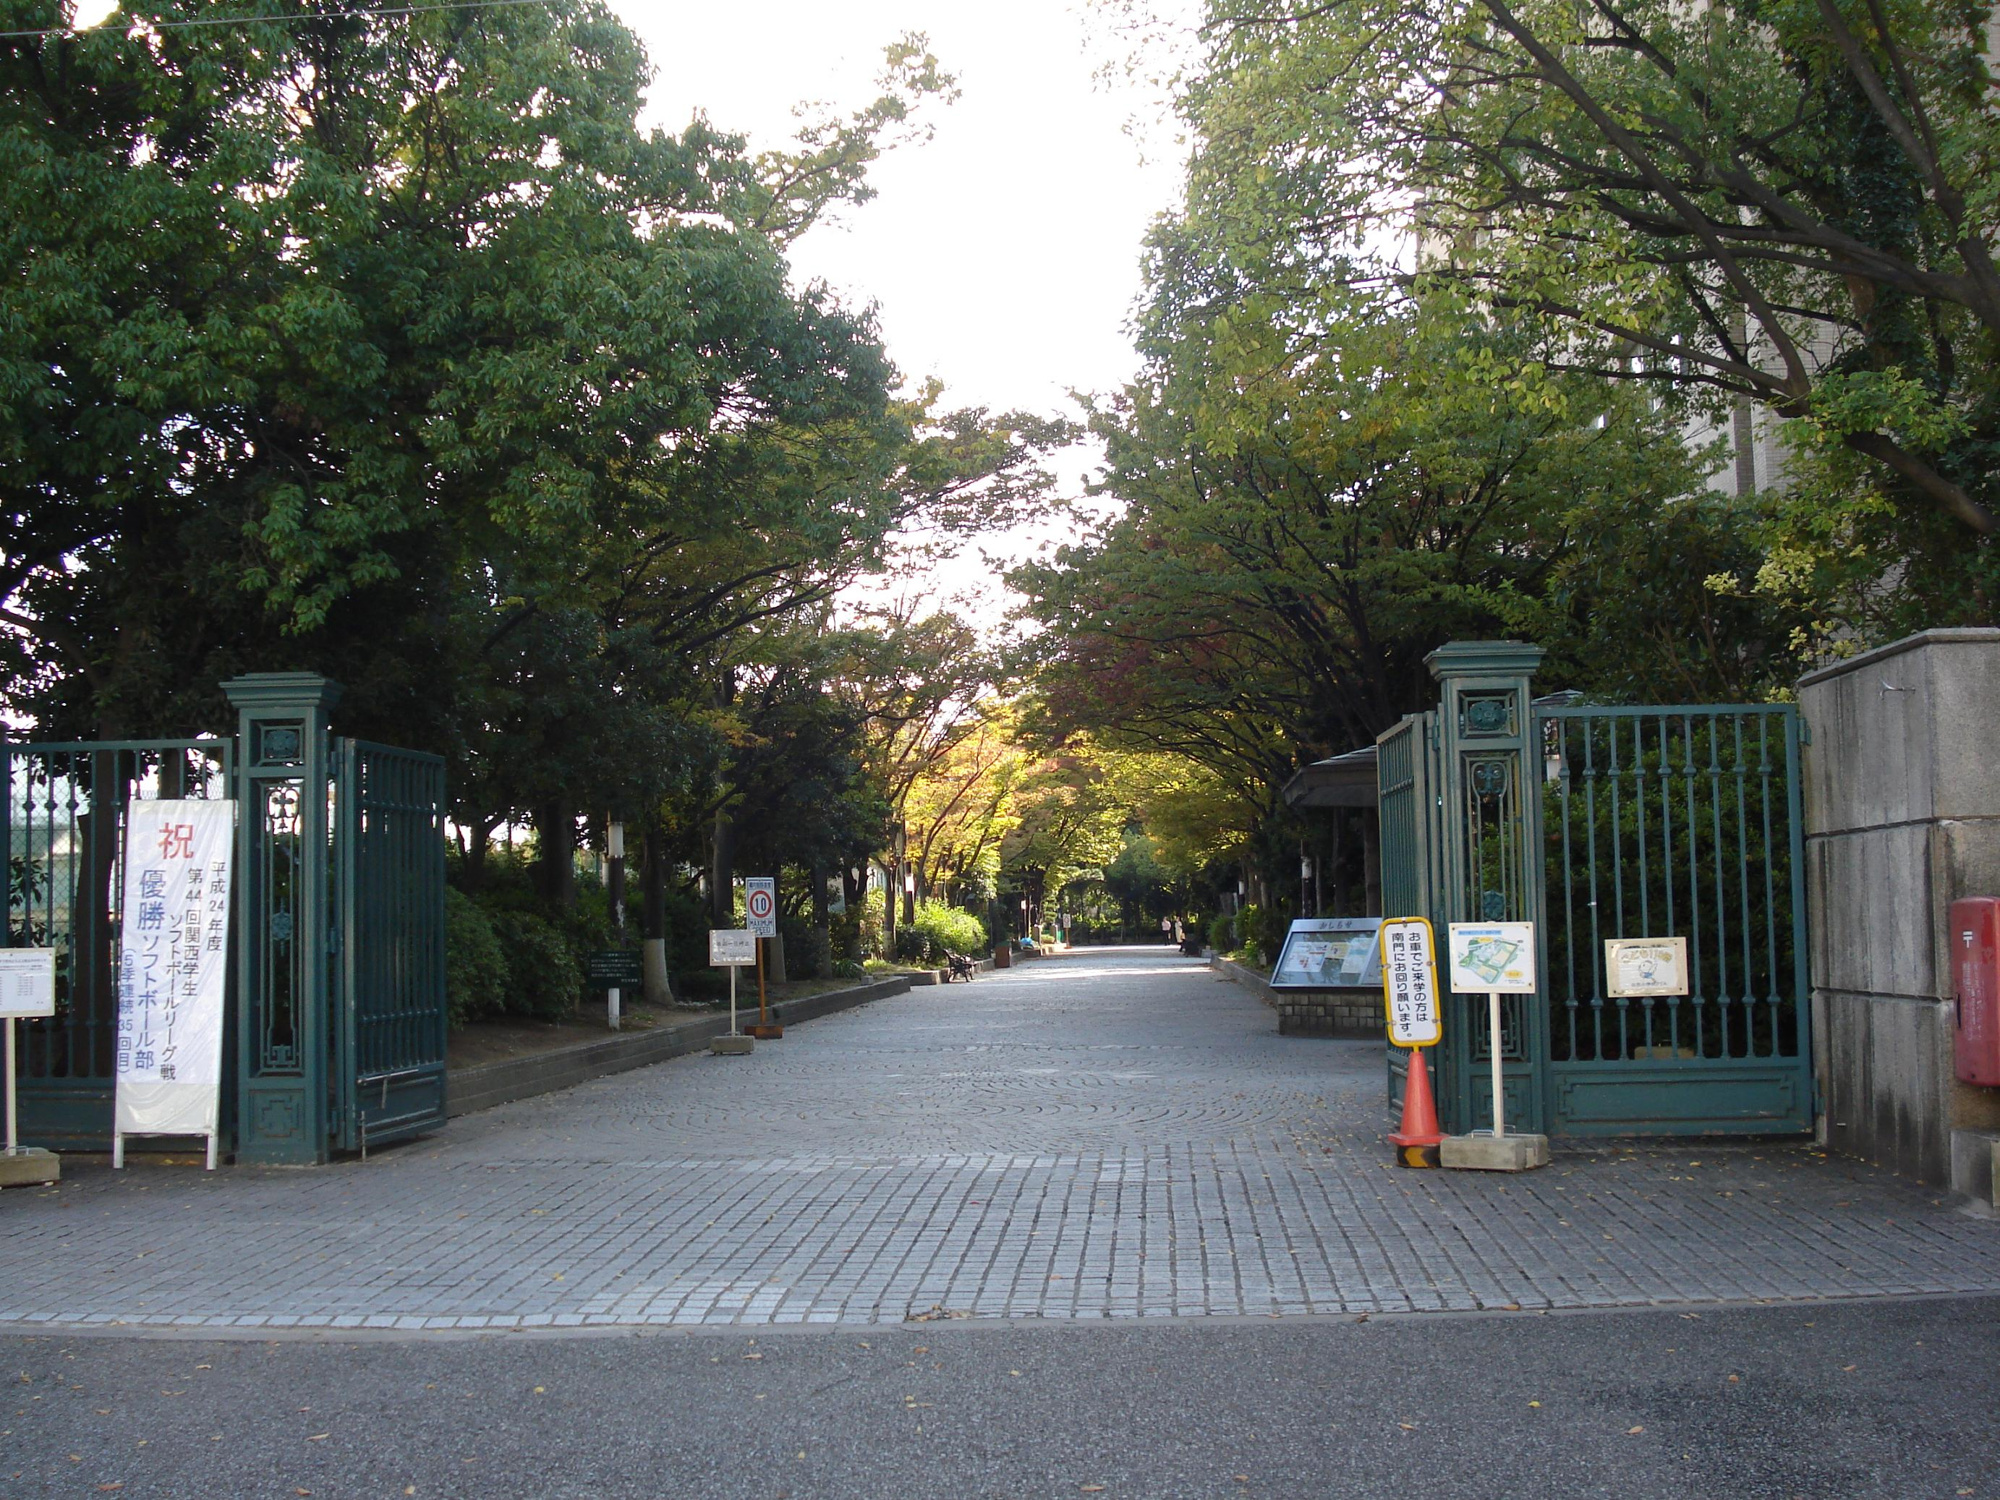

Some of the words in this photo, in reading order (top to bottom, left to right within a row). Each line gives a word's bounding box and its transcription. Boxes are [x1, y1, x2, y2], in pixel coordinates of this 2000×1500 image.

[158, 822, 194, 860] 祝
[181, 868, 203, 997] 第44回関西学生
[207, 861, 226, 952] 平成24年度
[755, 897, 767, 911] 10
[160, 914, 183, 1081] ソフトボールリーグ戦
[1391, 932, 1412, 1038] 南門にお回り願います。
[1408, 932, 1428, 1022] お車でご来学の方は
